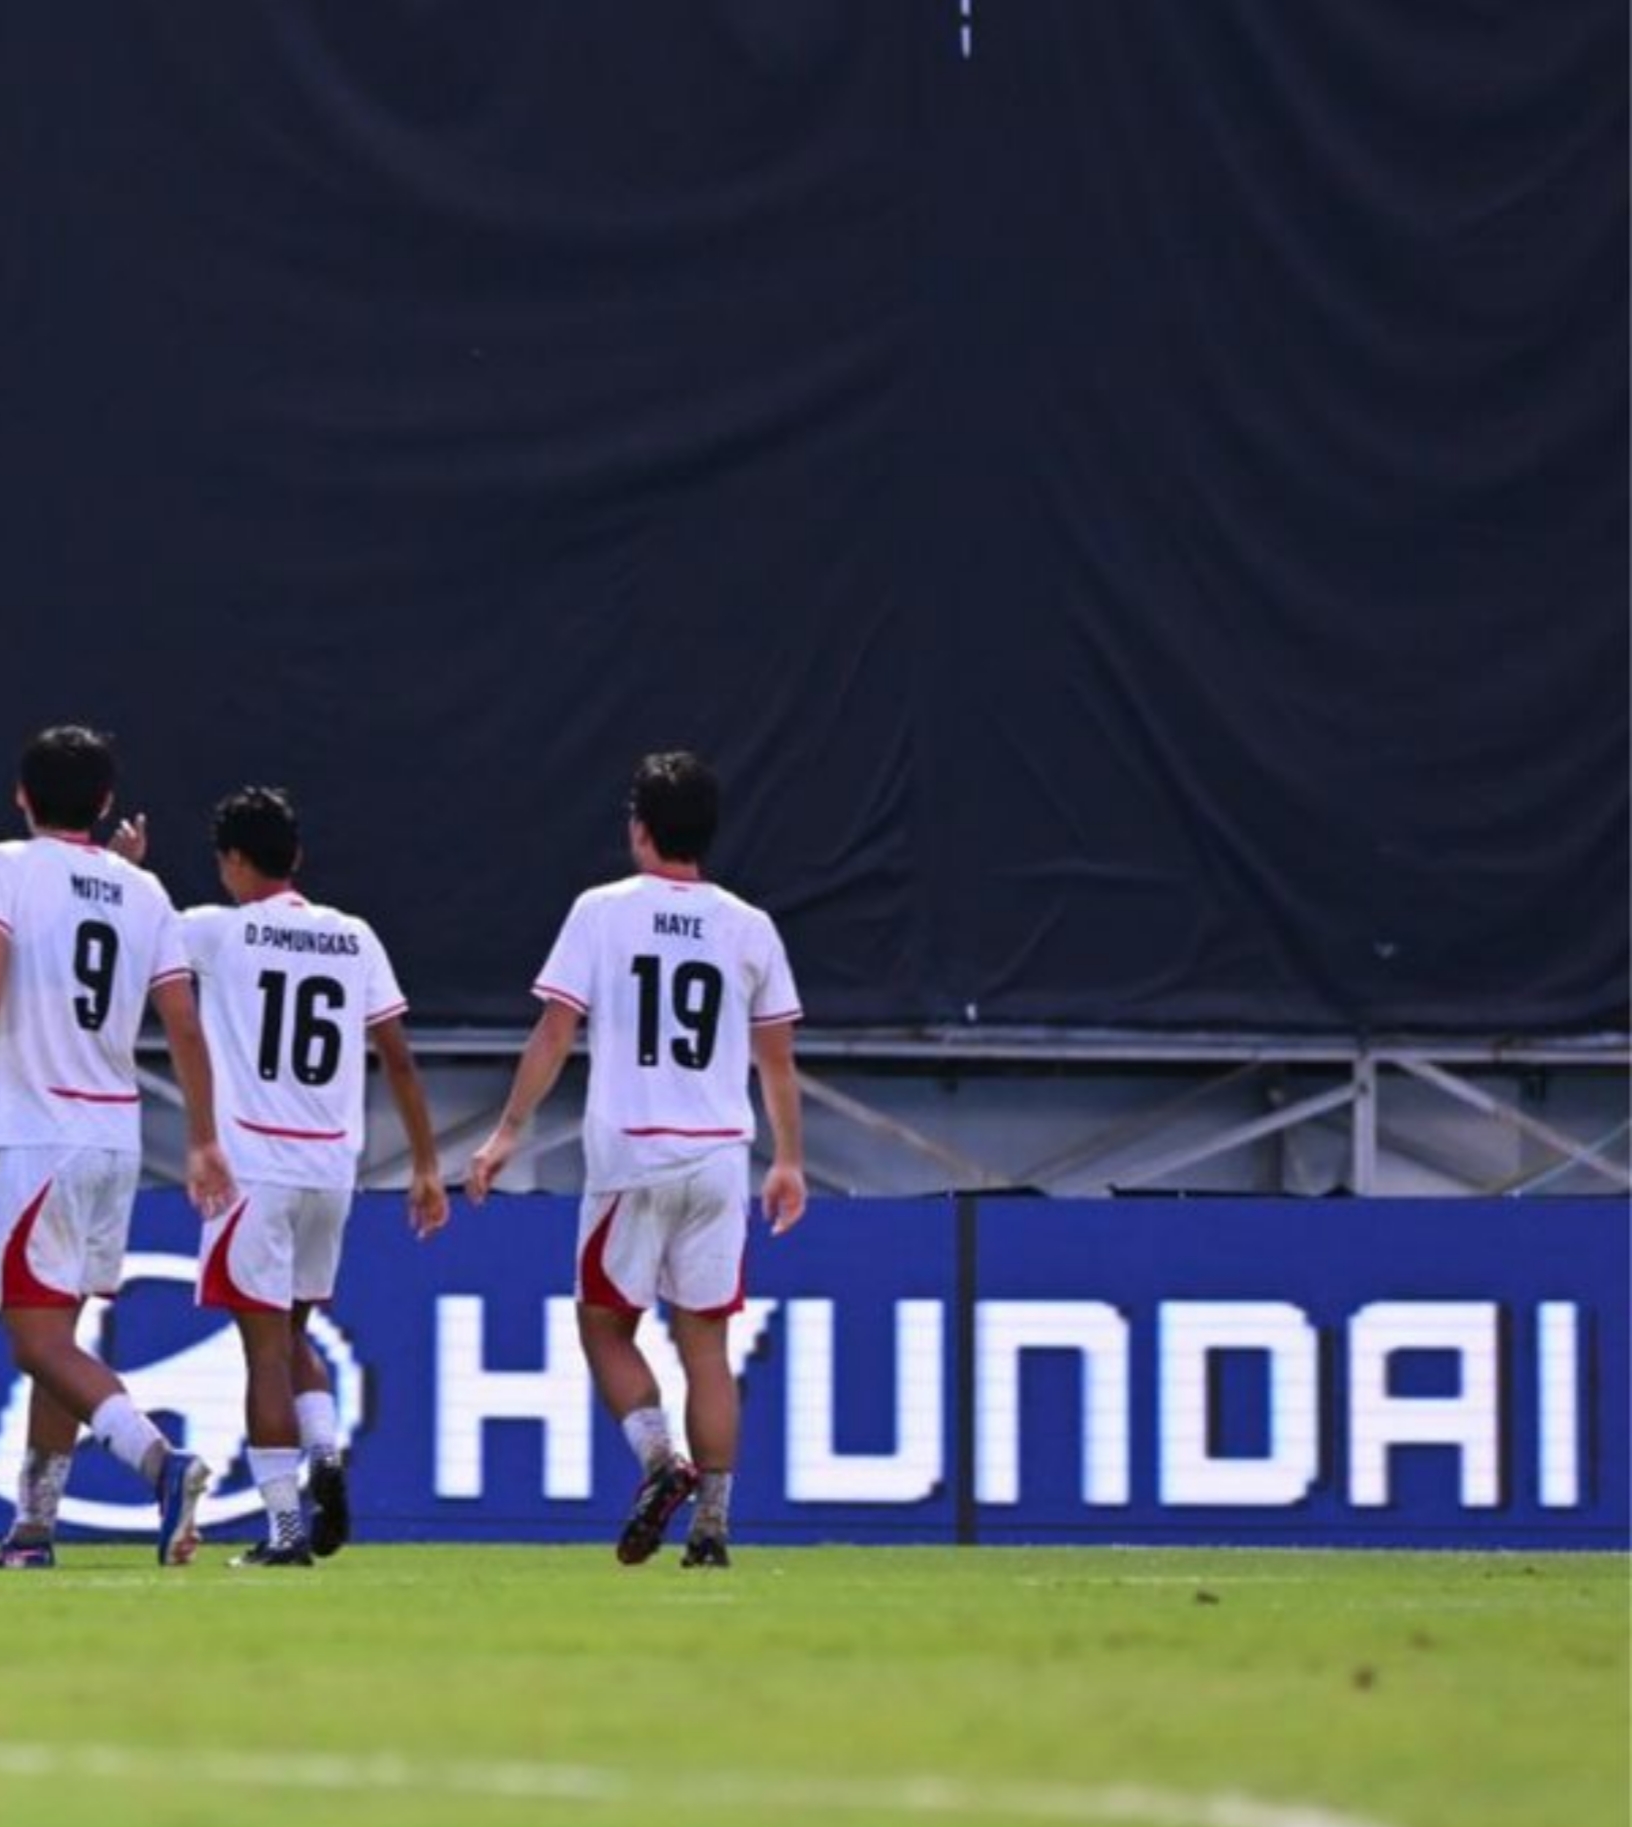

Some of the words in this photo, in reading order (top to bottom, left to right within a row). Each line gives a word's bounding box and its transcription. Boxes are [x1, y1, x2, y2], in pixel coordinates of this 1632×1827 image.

[70, 873, 124, 907] MITCH
[652, 911, 704, 940] HAYE
[72, 919, 120, 1032] 9
[257, 969, 346, 1087] 16
[630, 954, 723, 1071] 19
